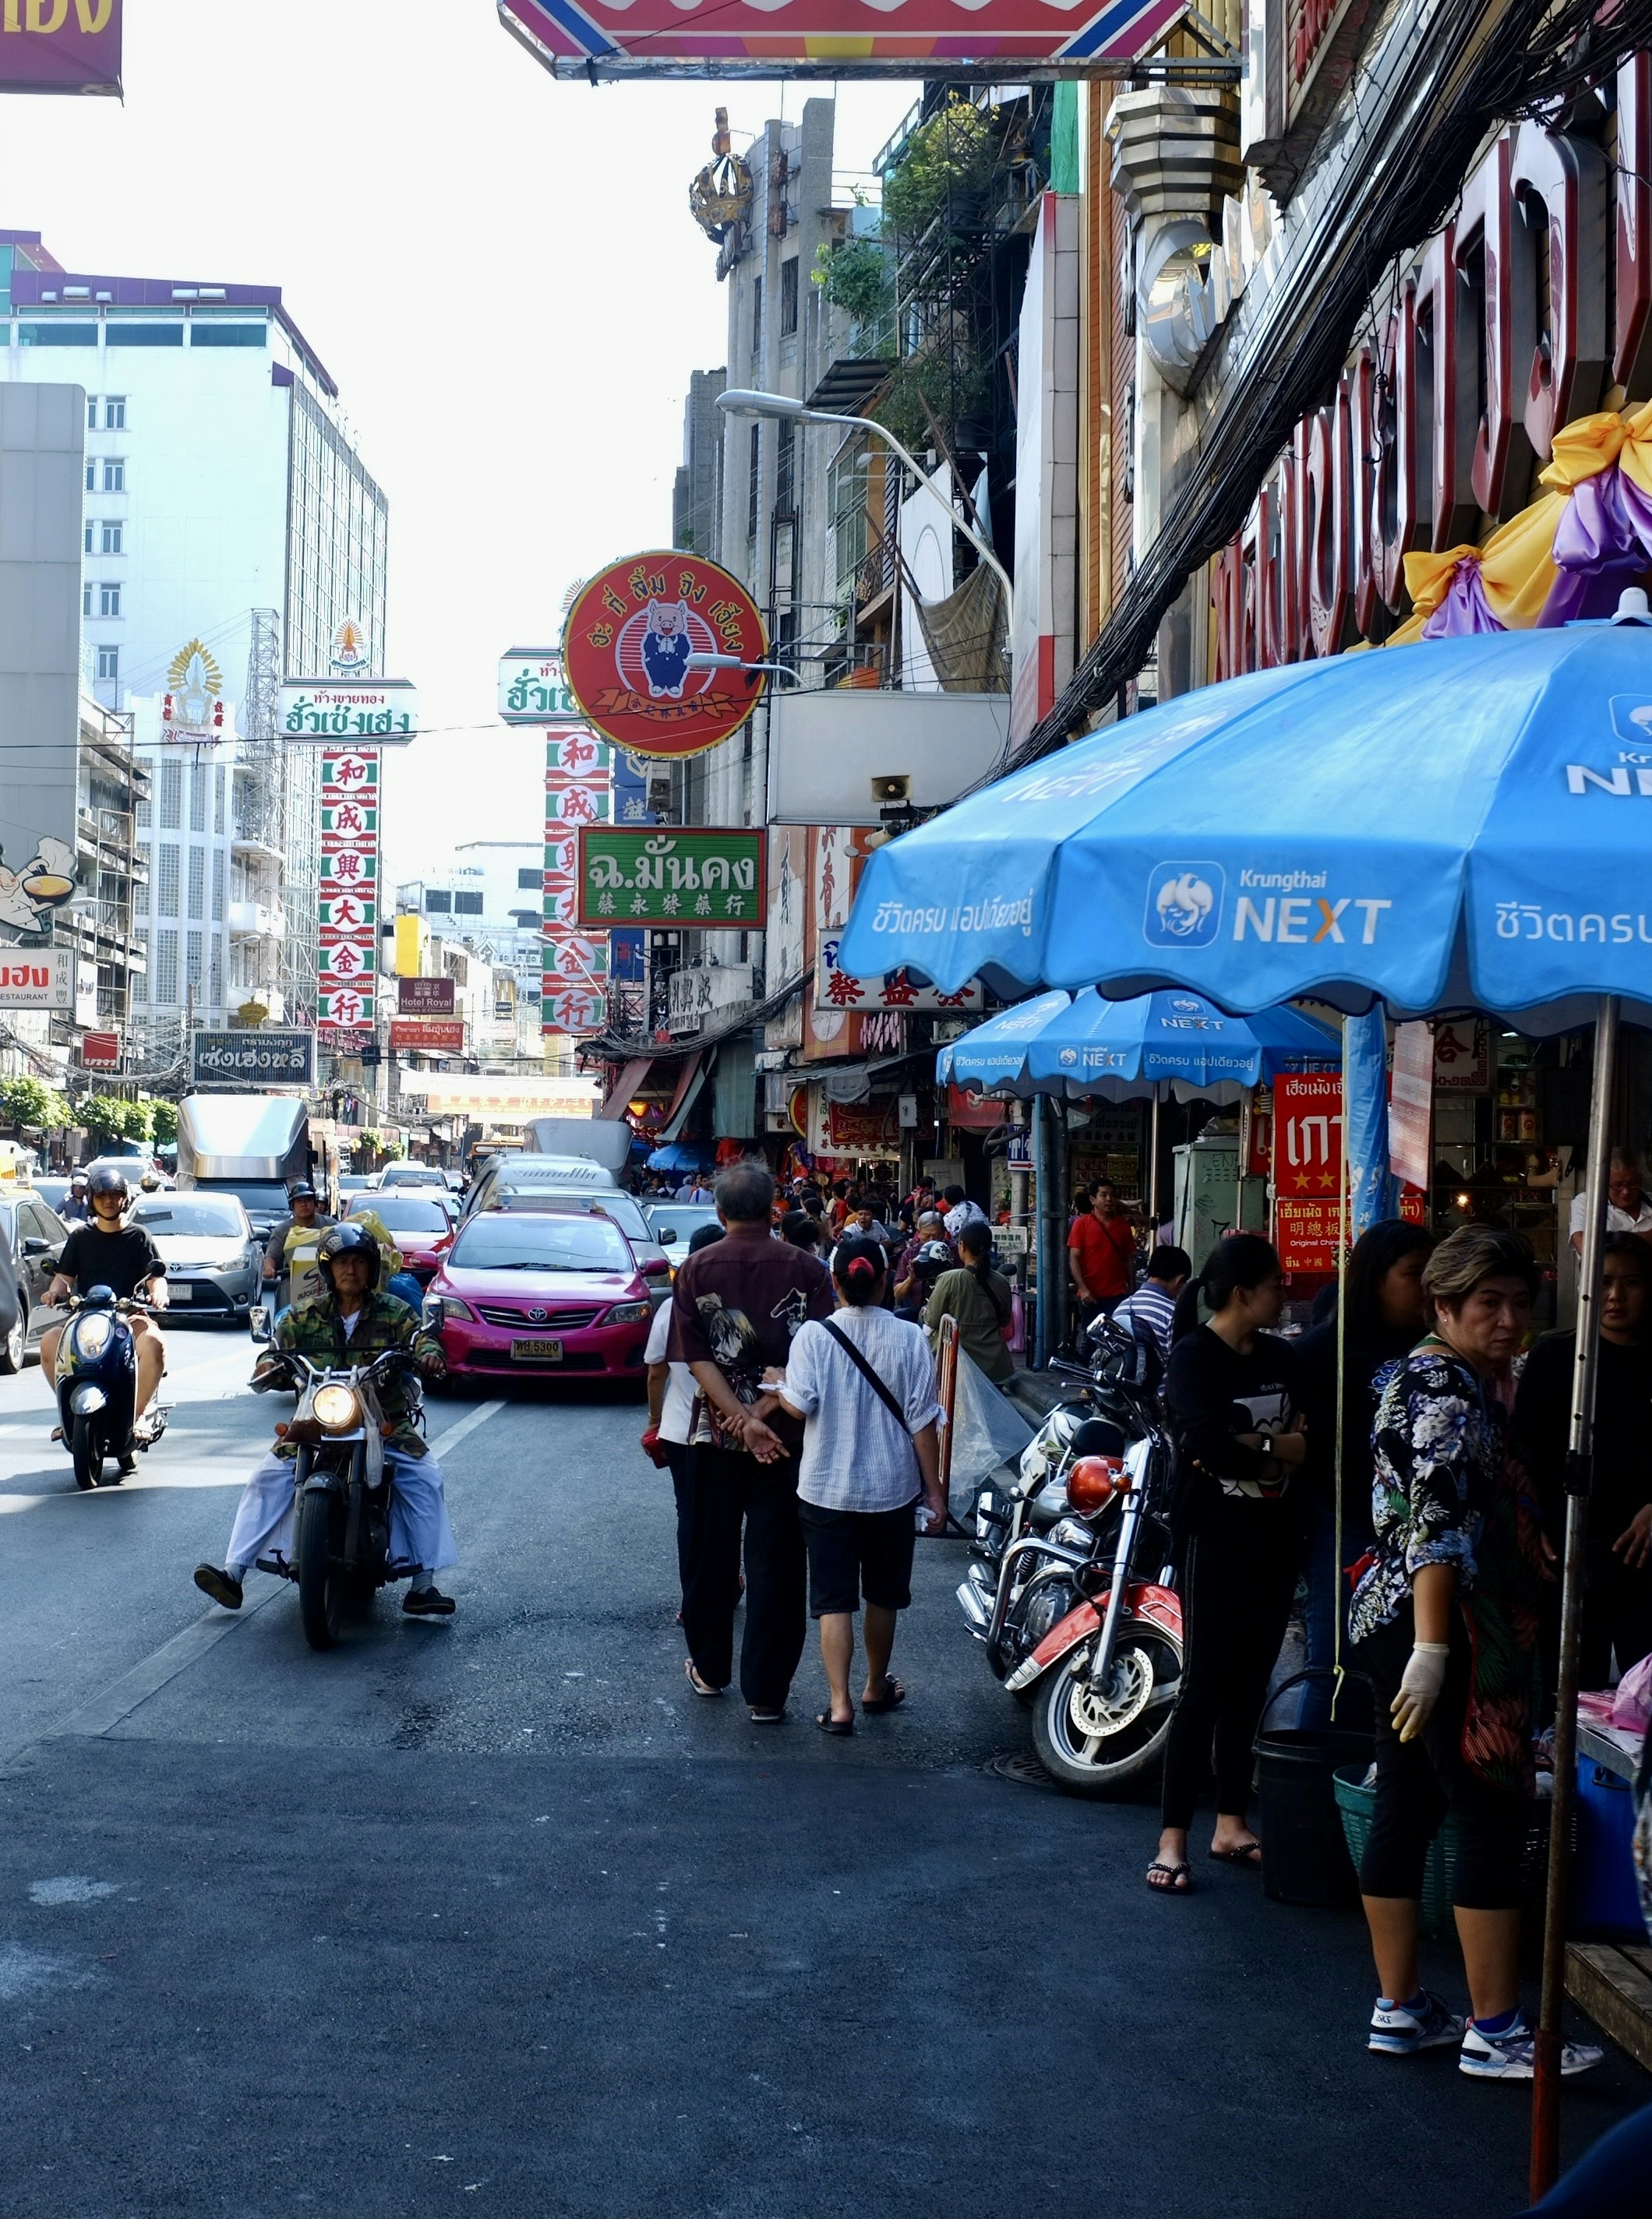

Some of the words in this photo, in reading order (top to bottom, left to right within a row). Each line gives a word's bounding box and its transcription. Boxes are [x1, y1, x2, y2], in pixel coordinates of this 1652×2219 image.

[539, 662, 560, 676] ห้า
[313, 690, 385, 704] ห้างขายทอง
[286, 695, 411, 734] ฮั่วเซ่งเฮง
[589, 834, 754, 891] ฉ.มั่นคง
[1240, 870, 1327, 893] Krungthai
[872, 901, 947, 933] ชีวิตครบ
[1233, 898, 1392, 945] NEXT
[401, 997, 424, 1006] Hotel
[426, 998, 451, 1007] Royal
[1160, 1018, 1224, 1031] NEXT
[199, 1045, 306, 1068] เซ่งเฮงหลี
[955, 1056, 985, 1067] ชีวิตครบ
[1083, 1054, 1127, 1066] NEXT
[1149, 1053, 1190, 1067] ชีวิตครบ
[1193, 1055, 1255, 1072] แอปเดียวอยู่
[1286, 1079, 1330, 1096] เฮียเม้ง
[1280, 1202, 1322, 1218] เฮียเม้ง
[534, 1342, 559, 1352] 5300
